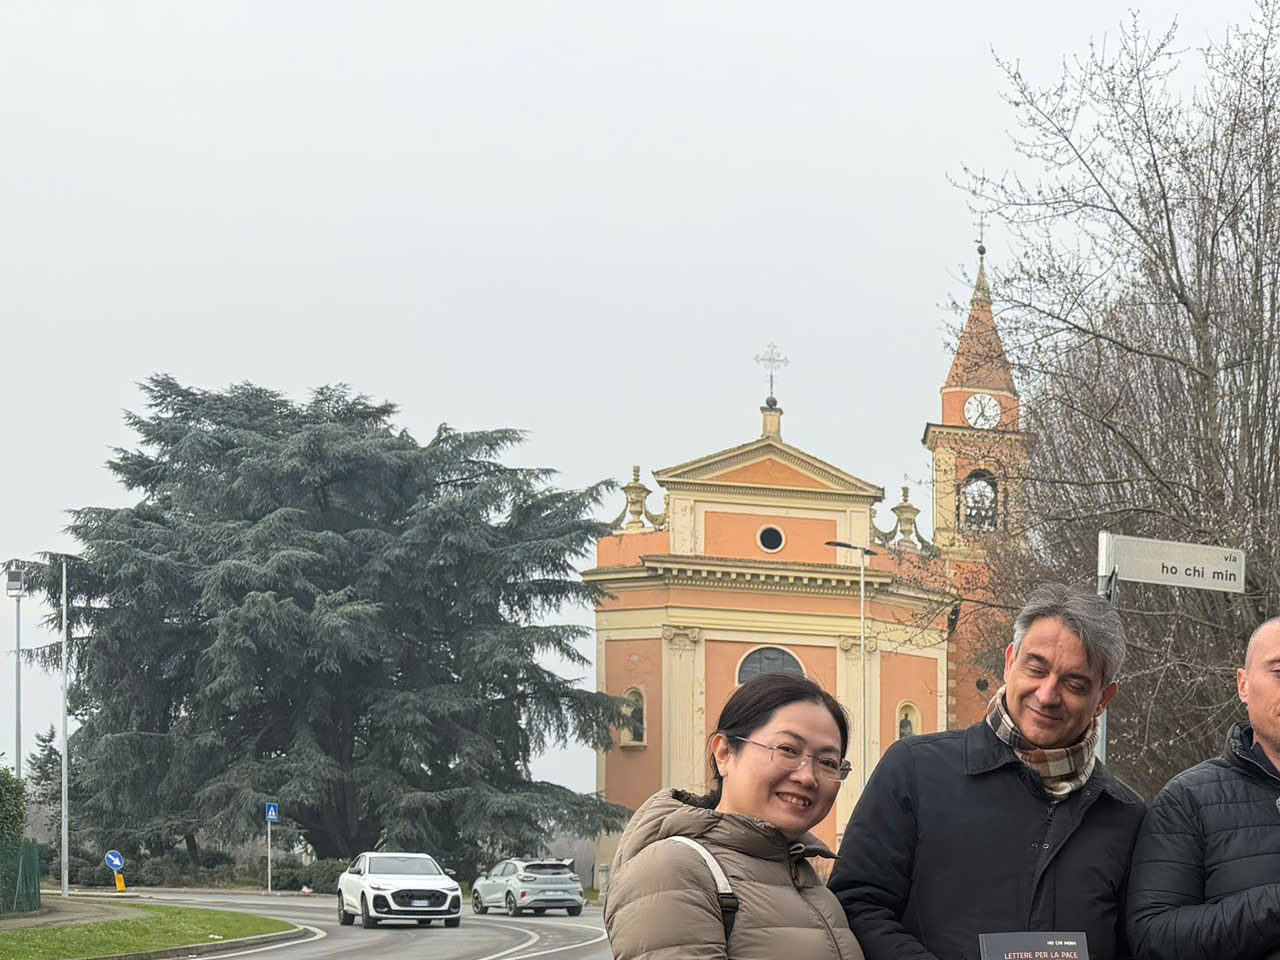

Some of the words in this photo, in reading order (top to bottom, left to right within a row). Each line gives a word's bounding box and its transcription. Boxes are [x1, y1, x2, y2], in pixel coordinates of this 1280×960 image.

[1224, 554, 1237, 562] via
[1161, 563, 1178, 575] ho
[1185, 566, 1205, 579] chi
[1212, 570, 1237, 582] min
[1004, 952, 1033, 960] LETTERE
[1061, 951, 1078, 959] PACE
